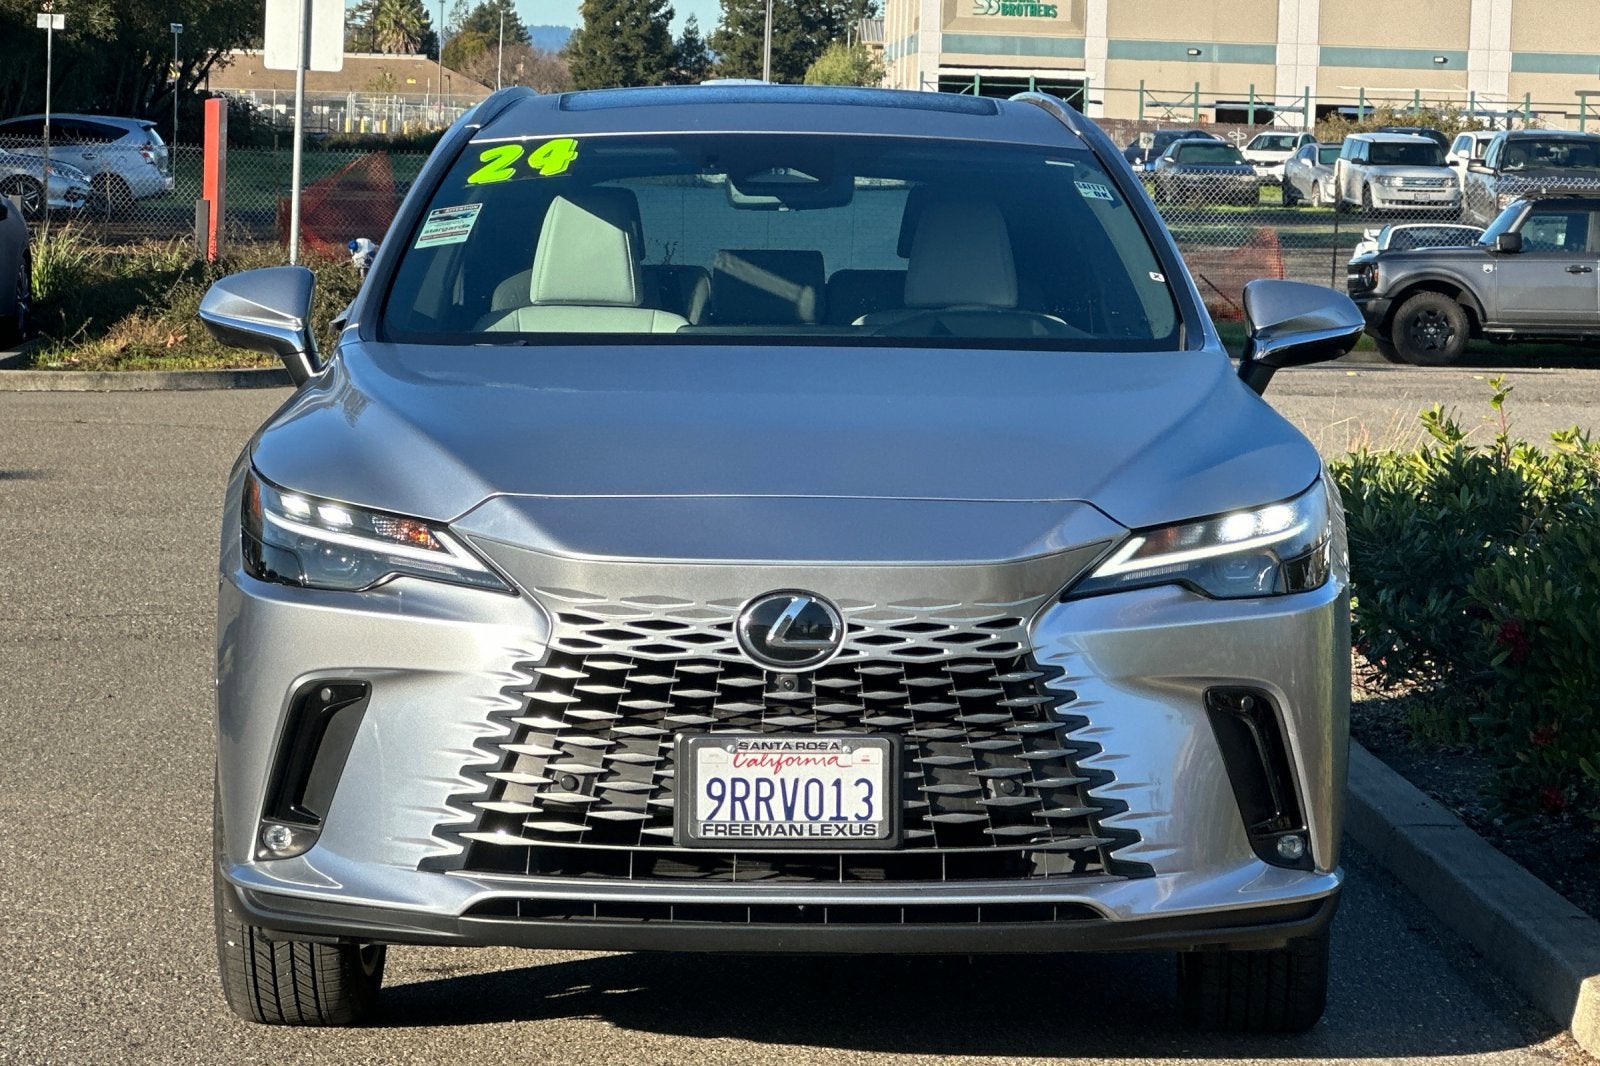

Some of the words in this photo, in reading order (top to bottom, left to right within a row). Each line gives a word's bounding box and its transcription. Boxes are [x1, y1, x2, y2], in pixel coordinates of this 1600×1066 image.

[1000, 3, 1058, 18] BROTHERS
[467, 138, 579, 185] 24
[738, 741, 791, 751] SANTA
[795, 741, 840, 751] ROSA
[732, 752, 853, 775] California
[706, 777, 874, 821] 9RRV013
[702, 823, 805, 837] FREEMAN
[808, 823, 876, 837] LEXUS
